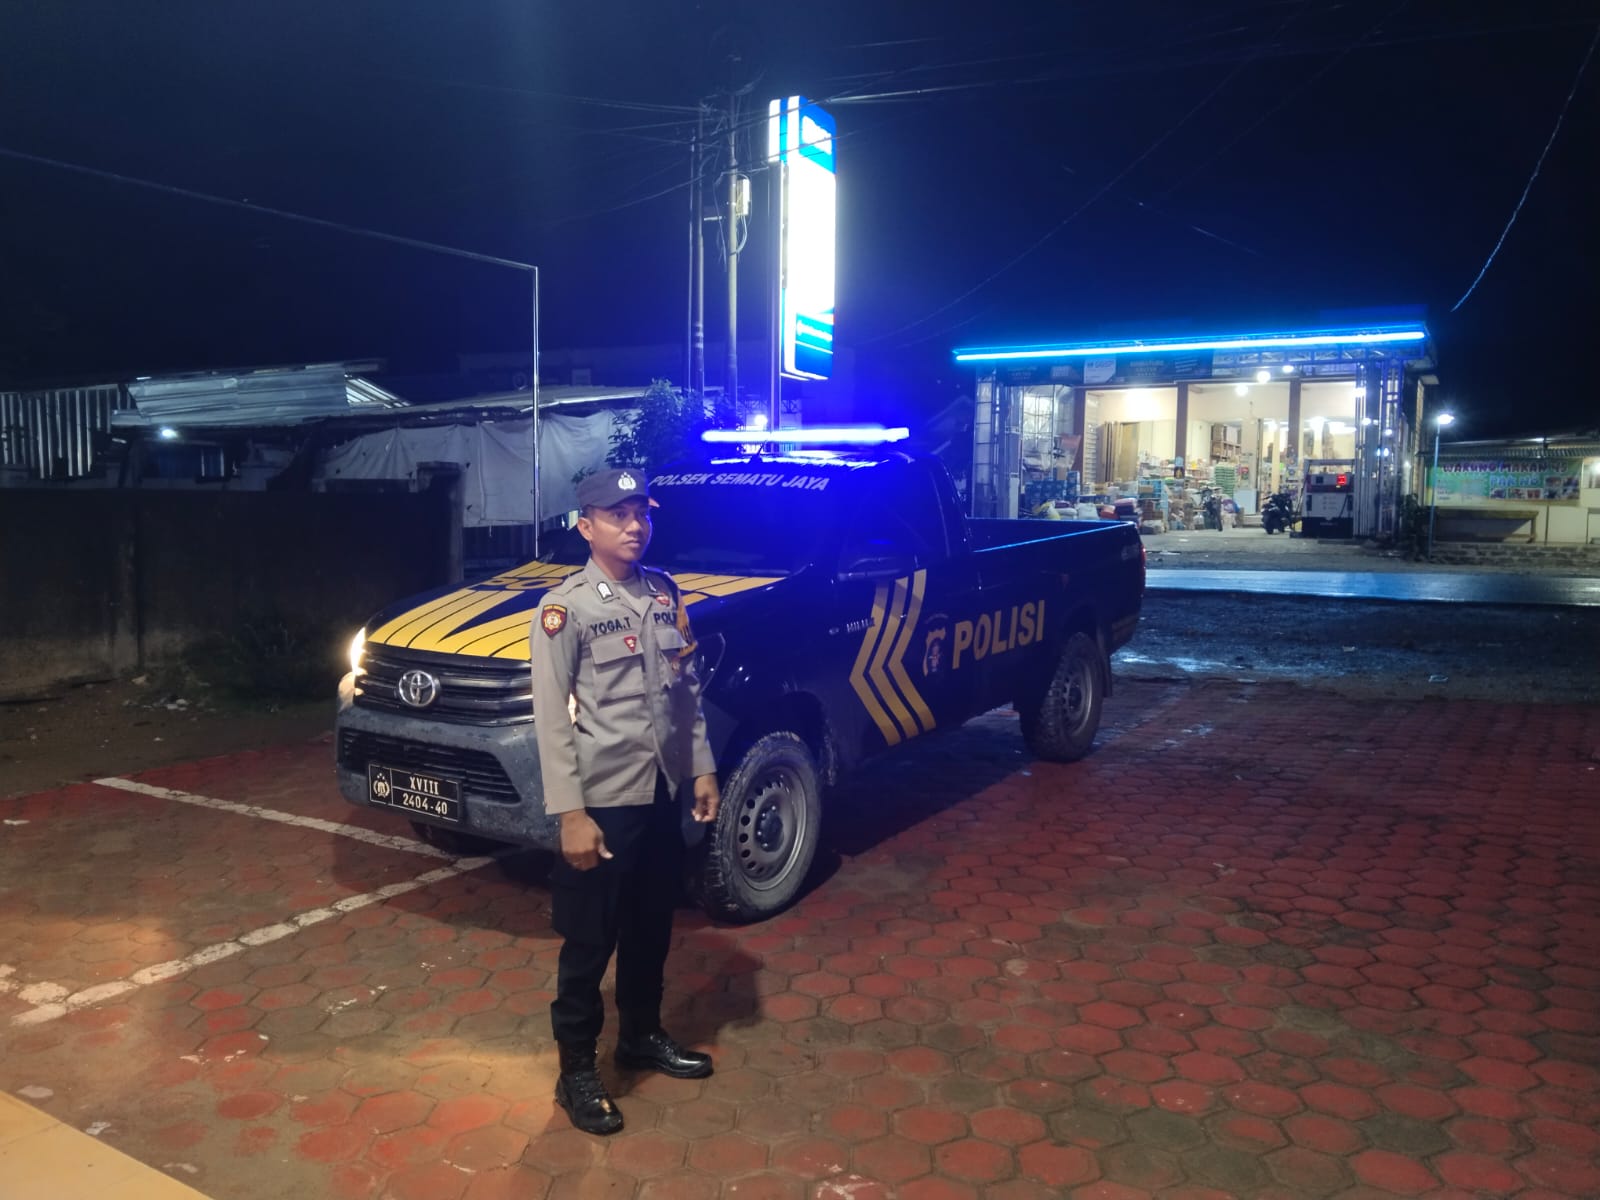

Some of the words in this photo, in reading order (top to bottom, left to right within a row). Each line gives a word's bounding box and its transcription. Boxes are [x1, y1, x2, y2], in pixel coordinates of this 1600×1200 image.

[1499, 461, 1548, 473] MAKAN
[648, 473, 713, 487] POLSEK
[710, 473, 785, 487] SEMATU
[782, 474, 830, 491] JAYA
[589, 616, 632, 638] YOGA.T
[952, 600, 1045, 669] POLISI
[410, 776, 439, 795] XVIII
